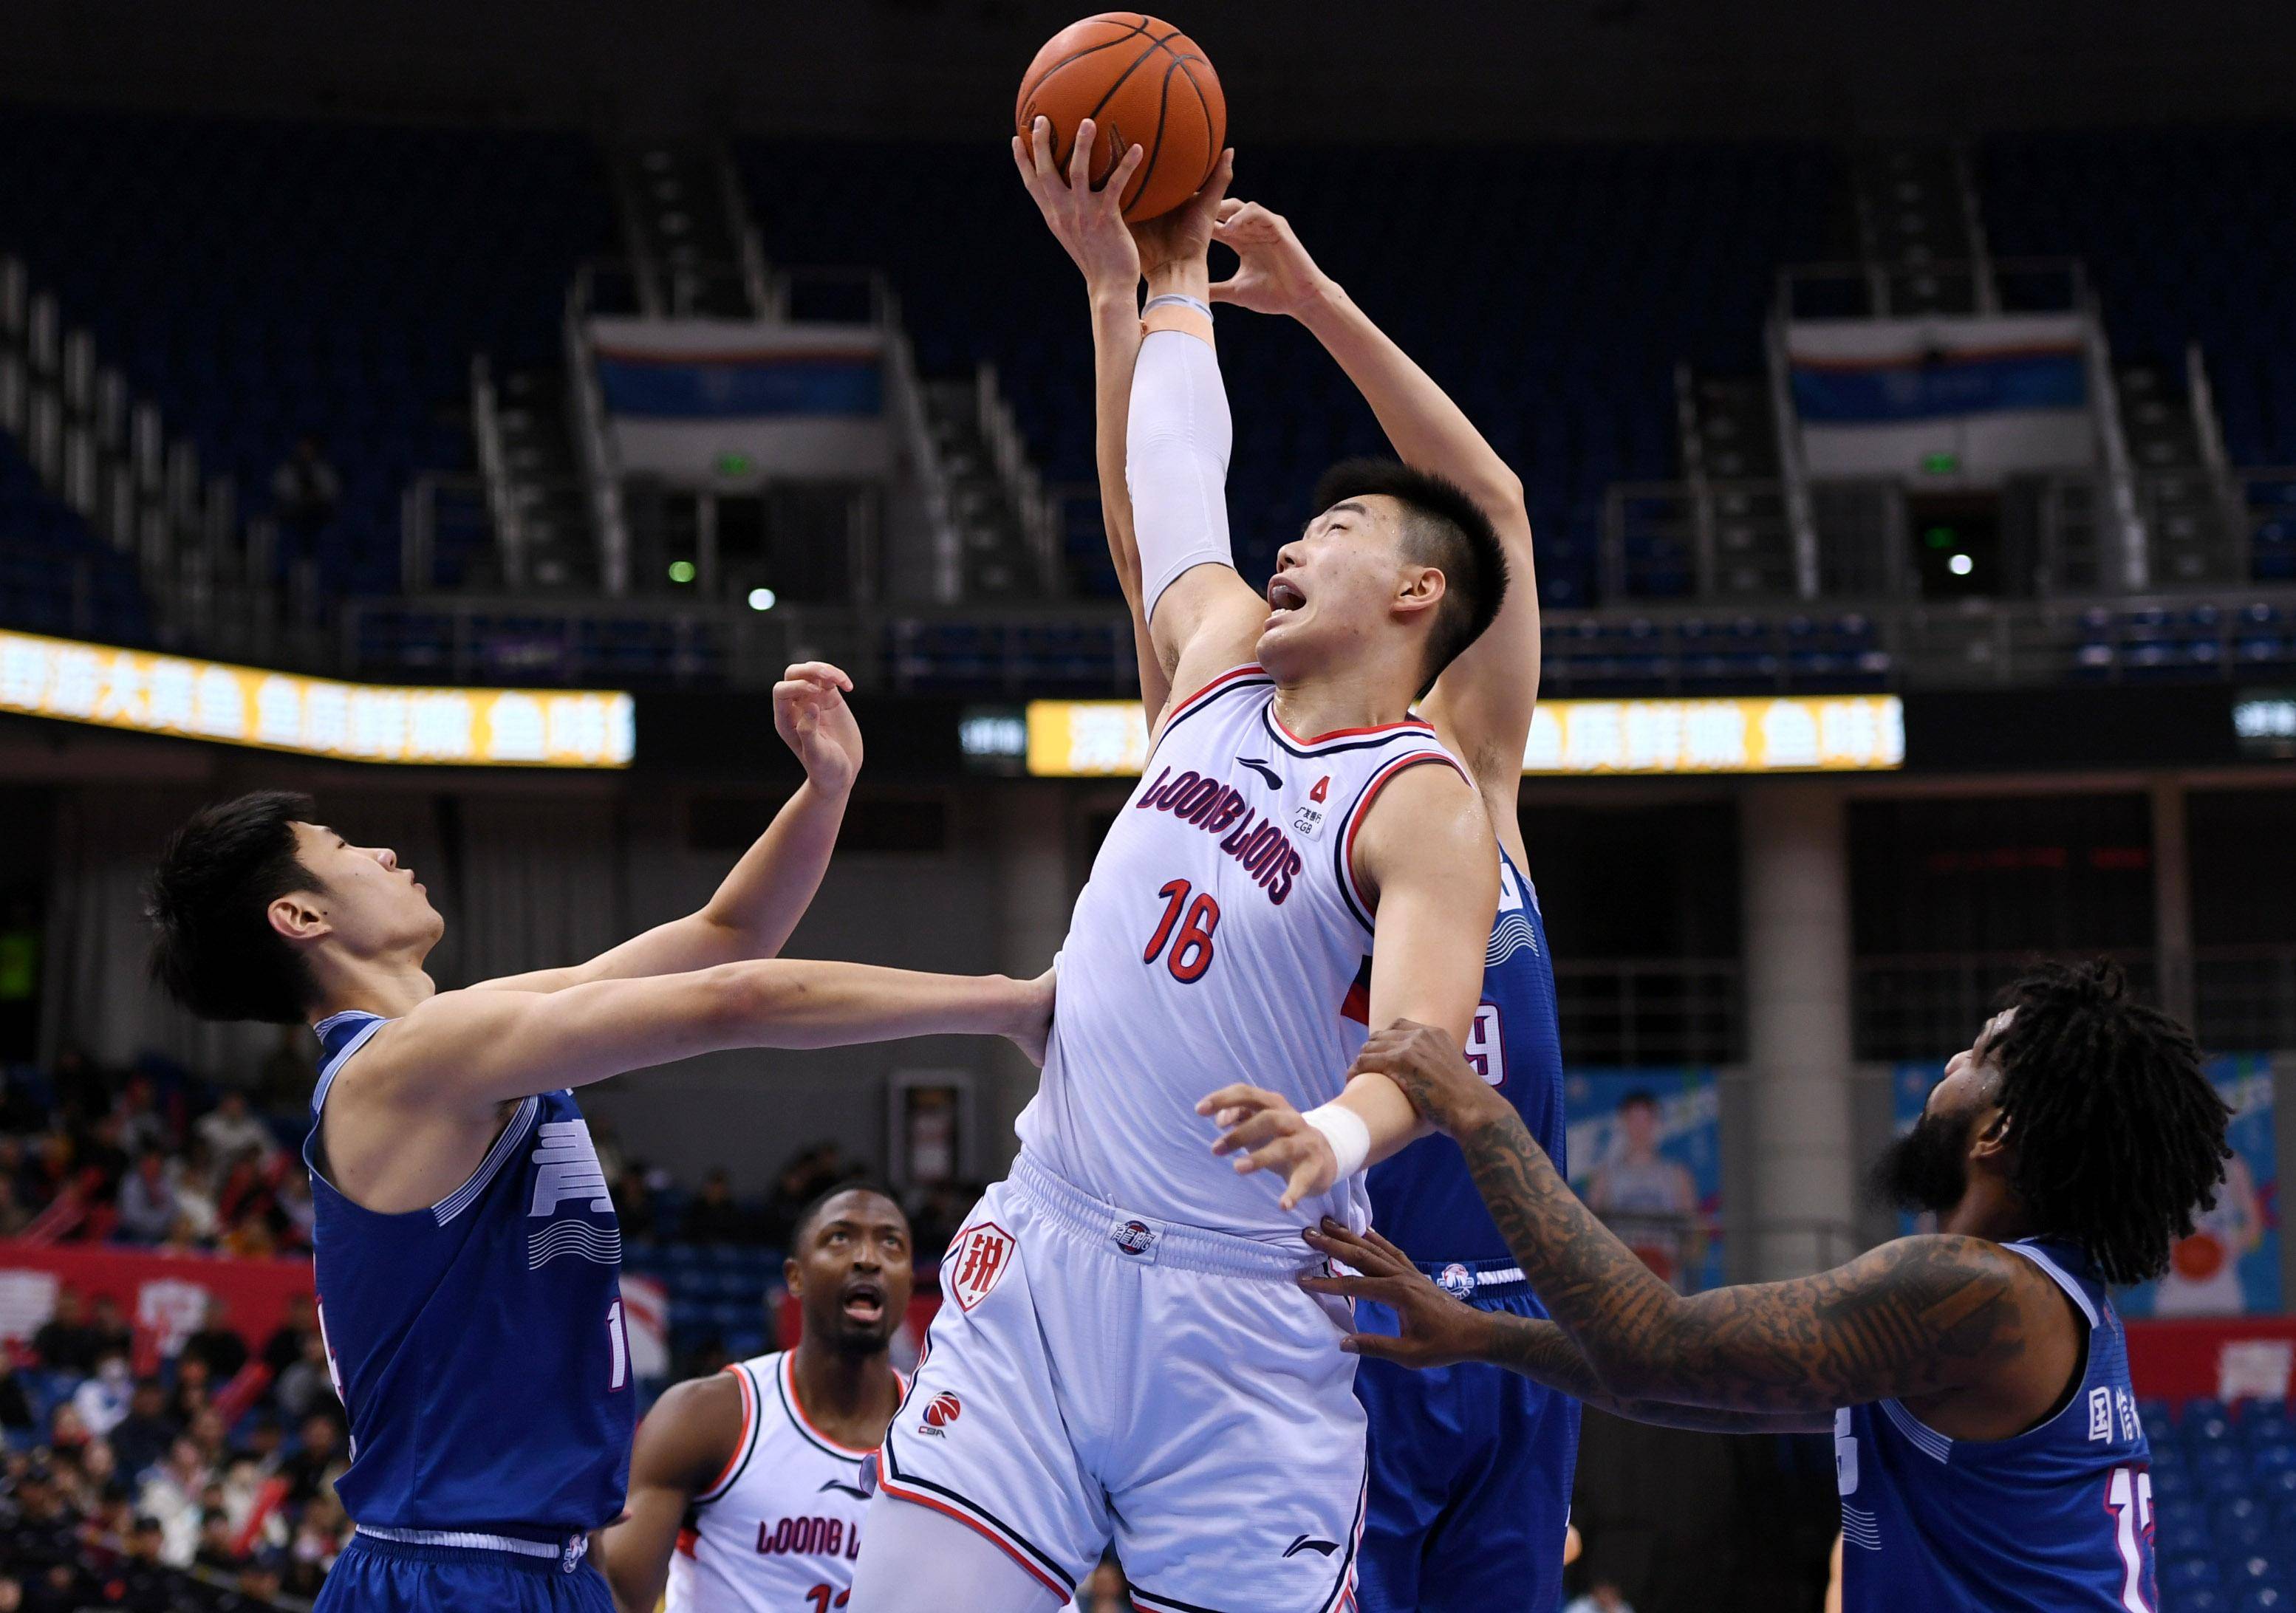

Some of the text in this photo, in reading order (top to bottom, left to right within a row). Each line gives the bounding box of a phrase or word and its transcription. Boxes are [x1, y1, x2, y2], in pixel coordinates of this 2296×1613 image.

[1294, 819, 1313, 834] CGB
[1295, 806, 1322, 824] 广发银行
[1220, 806, 1301, 905] LIONS
[1143, 878, 1220, 984] 16
